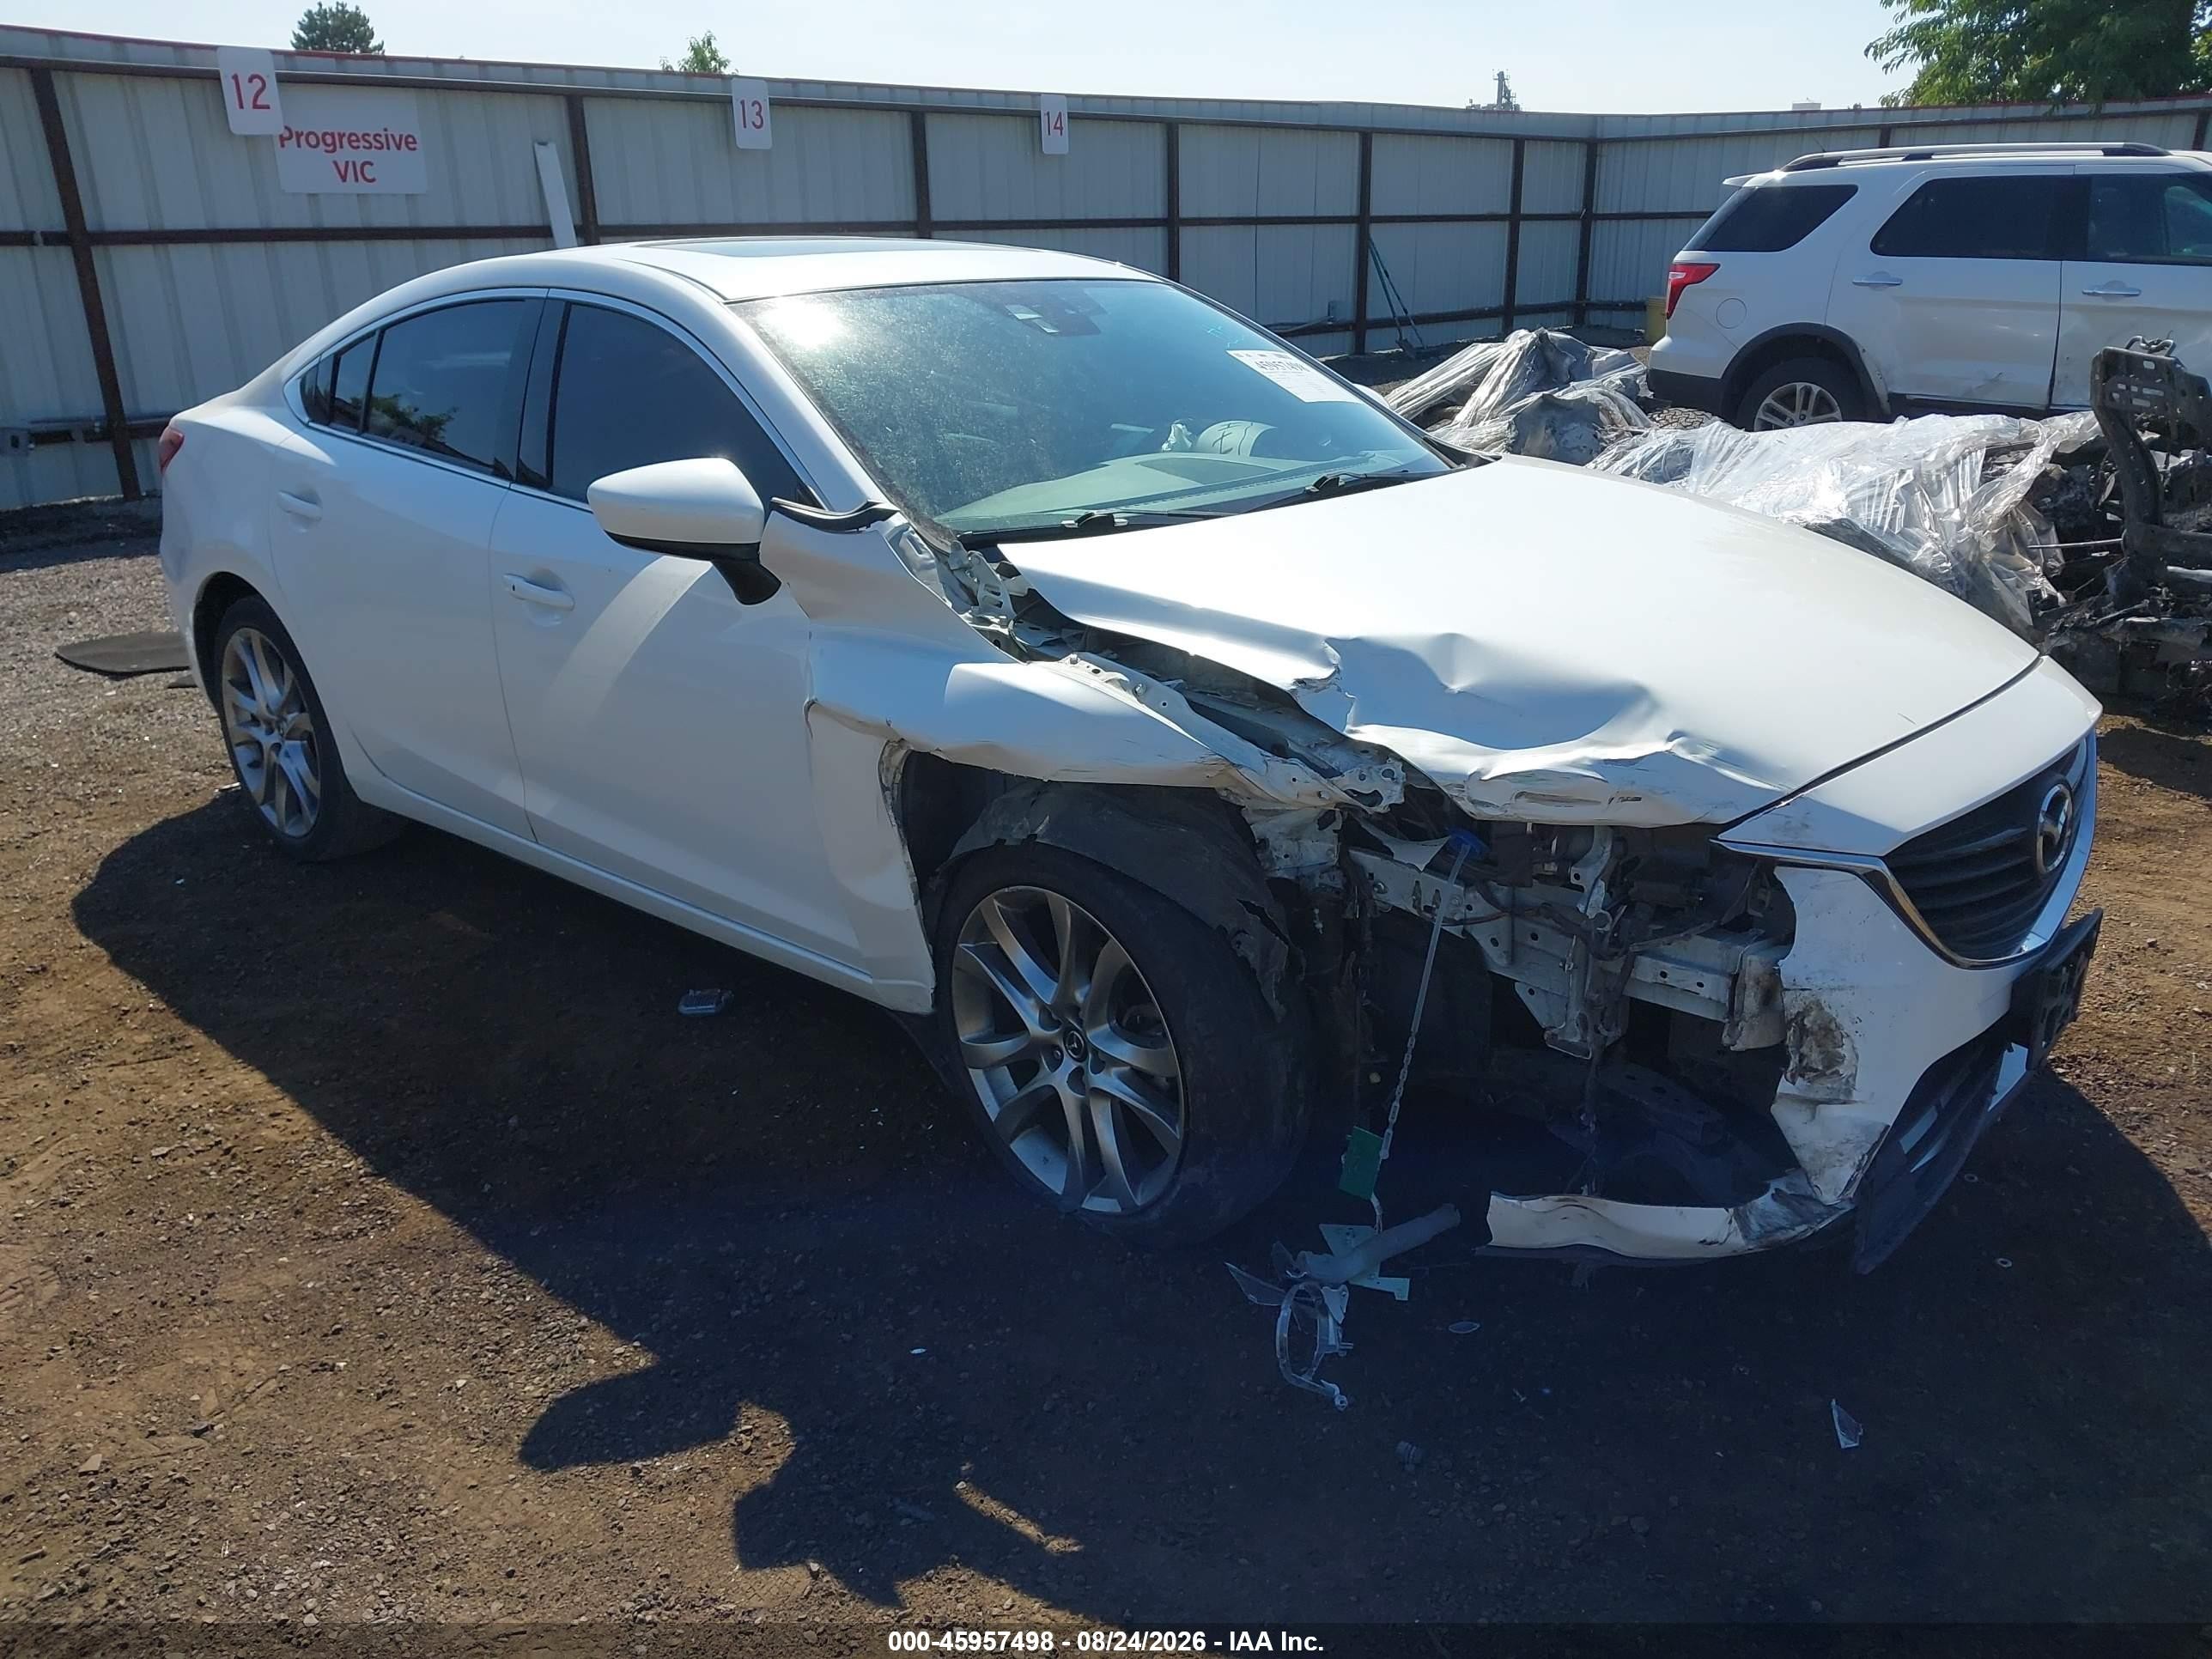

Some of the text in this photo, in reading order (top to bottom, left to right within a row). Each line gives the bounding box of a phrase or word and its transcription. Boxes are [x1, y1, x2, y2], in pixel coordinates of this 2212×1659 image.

[231, 74, 270, 109] 12
[739, 100, 764, 130] 13
[1043, 111, 1065, 137] 14
[278, 126, 417, 154] Progressive
[332, 161, 377, 183] VIC
